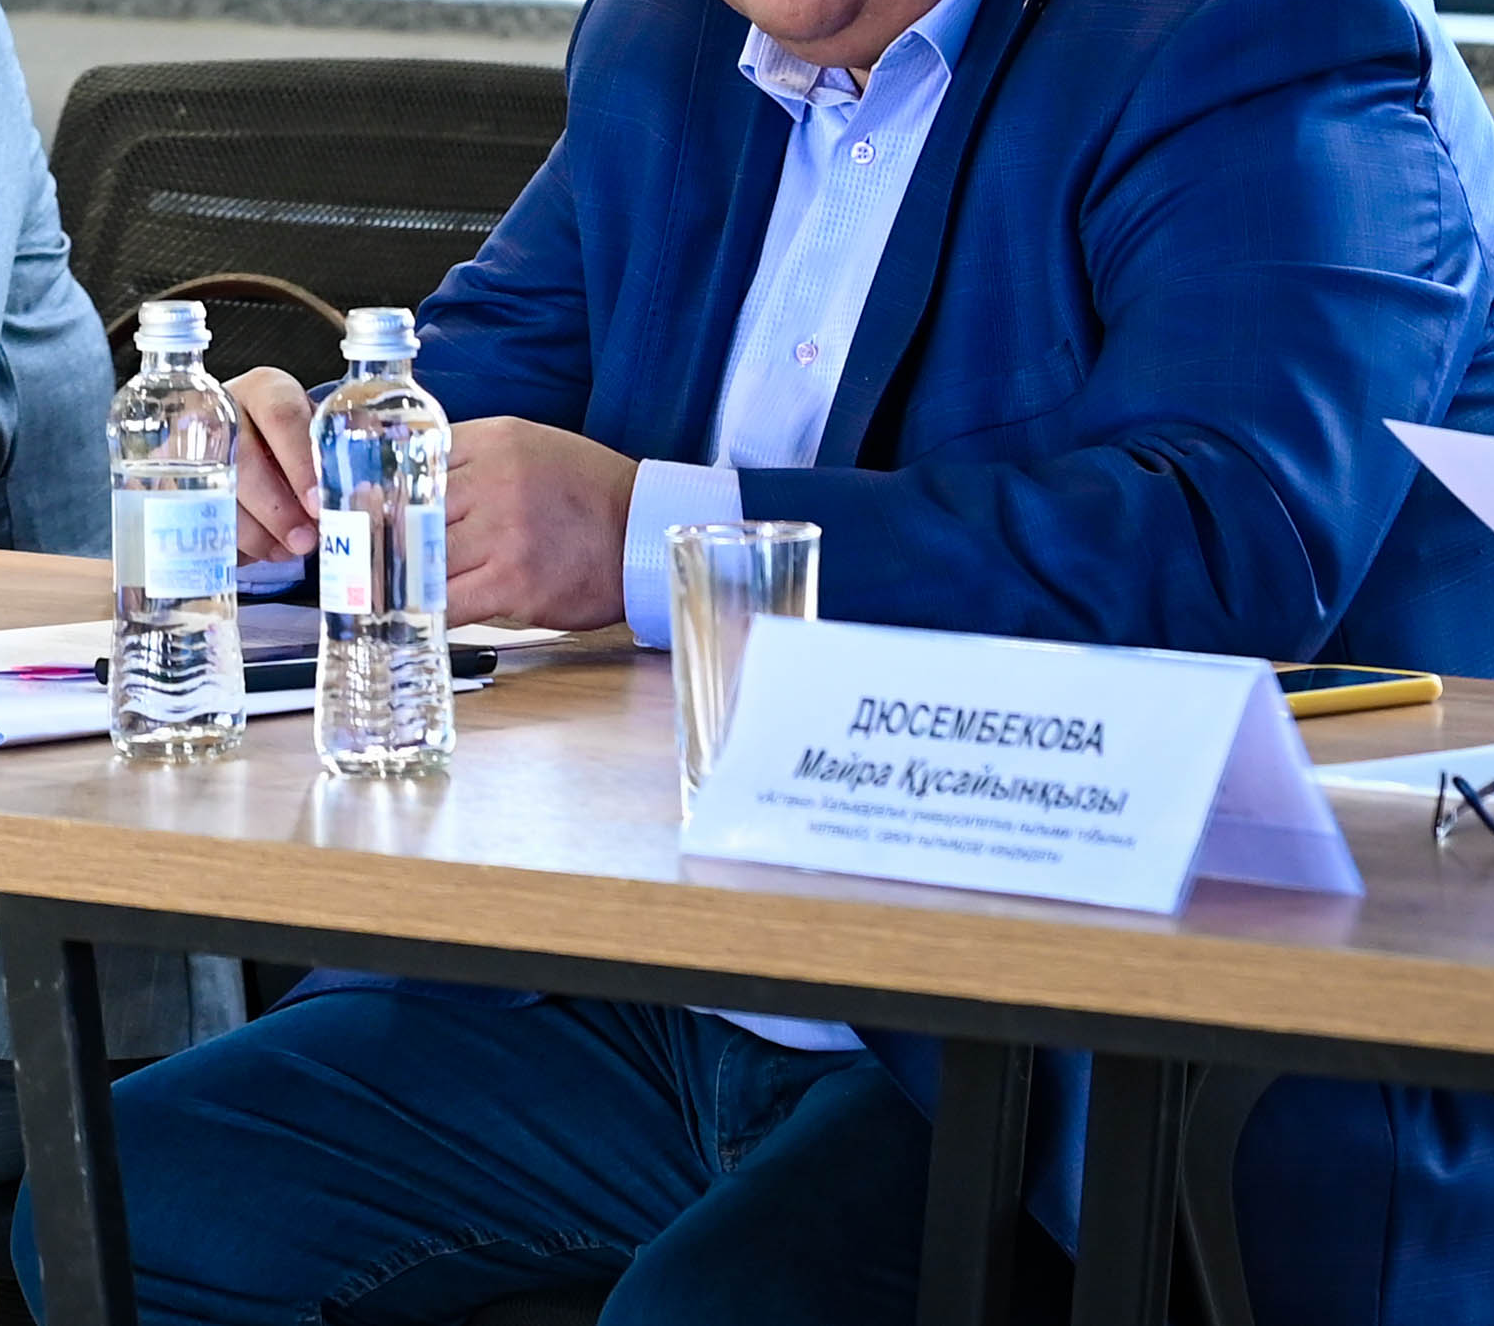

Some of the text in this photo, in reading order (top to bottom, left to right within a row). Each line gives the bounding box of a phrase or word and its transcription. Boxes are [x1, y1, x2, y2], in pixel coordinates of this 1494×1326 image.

[152, 525, 236, 552] TURA
[847, 697, 1104, 756] ДЮСЕМБЕКОВА
[793, 746, 893, 793] Майра
